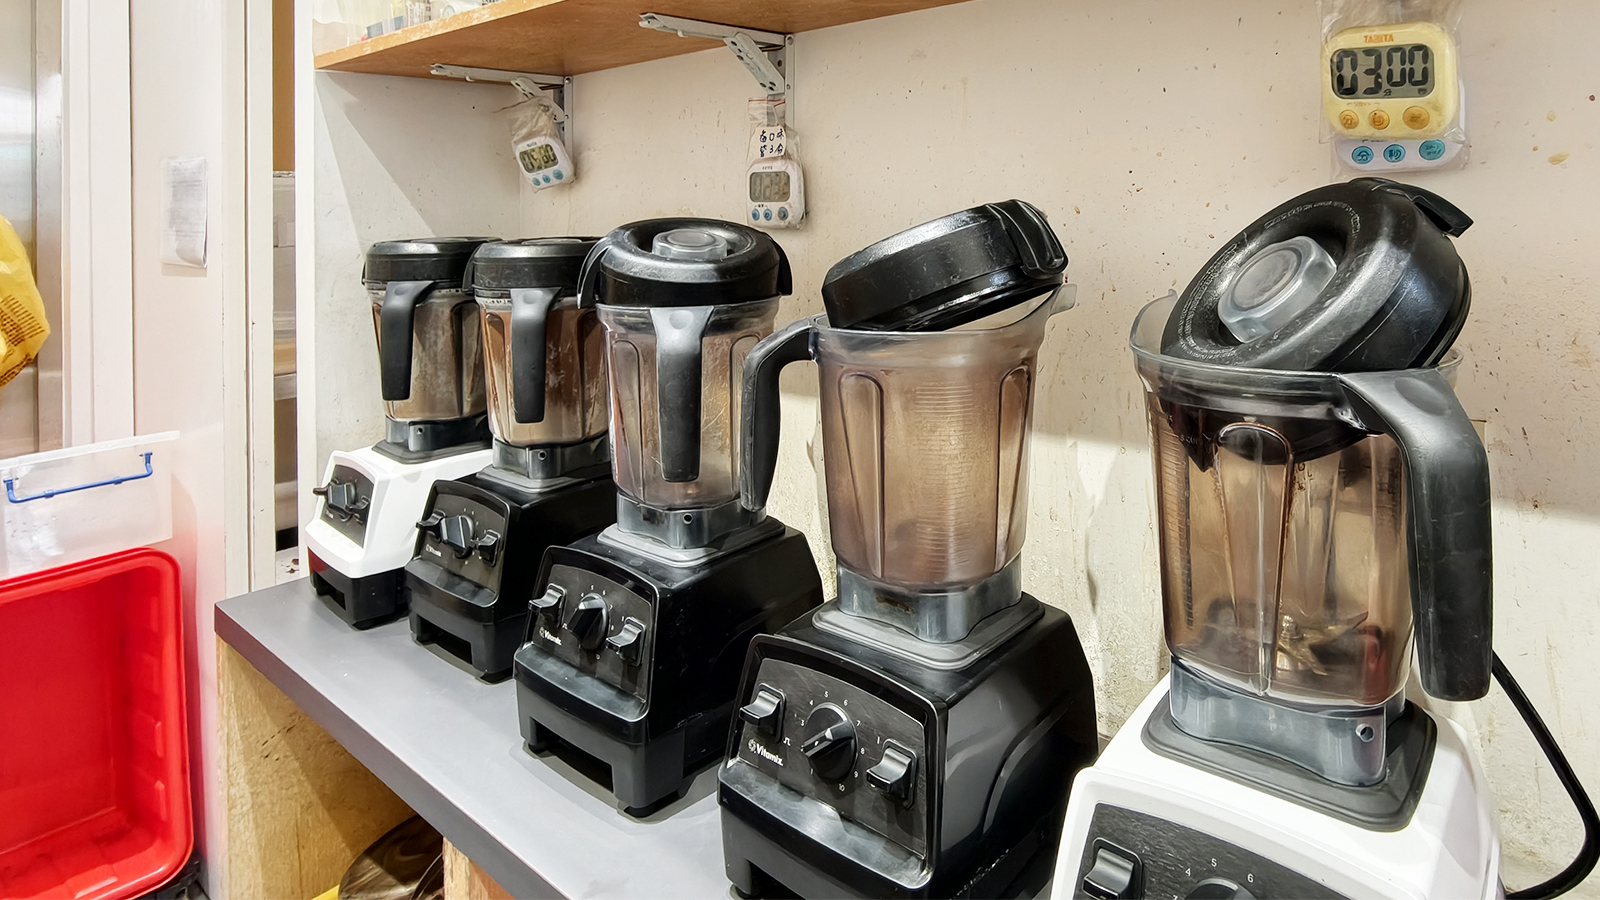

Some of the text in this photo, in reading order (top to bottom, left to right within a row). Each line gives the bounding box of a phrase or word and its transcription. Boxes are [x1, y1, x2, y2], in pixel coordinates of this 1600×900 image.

[756, 742, 784, 767] Vitamix
[1210, 858, 1217, 867] 5
[1185, 868, 1191, 877] 4
[1247, 873, 1254, 883] 6
